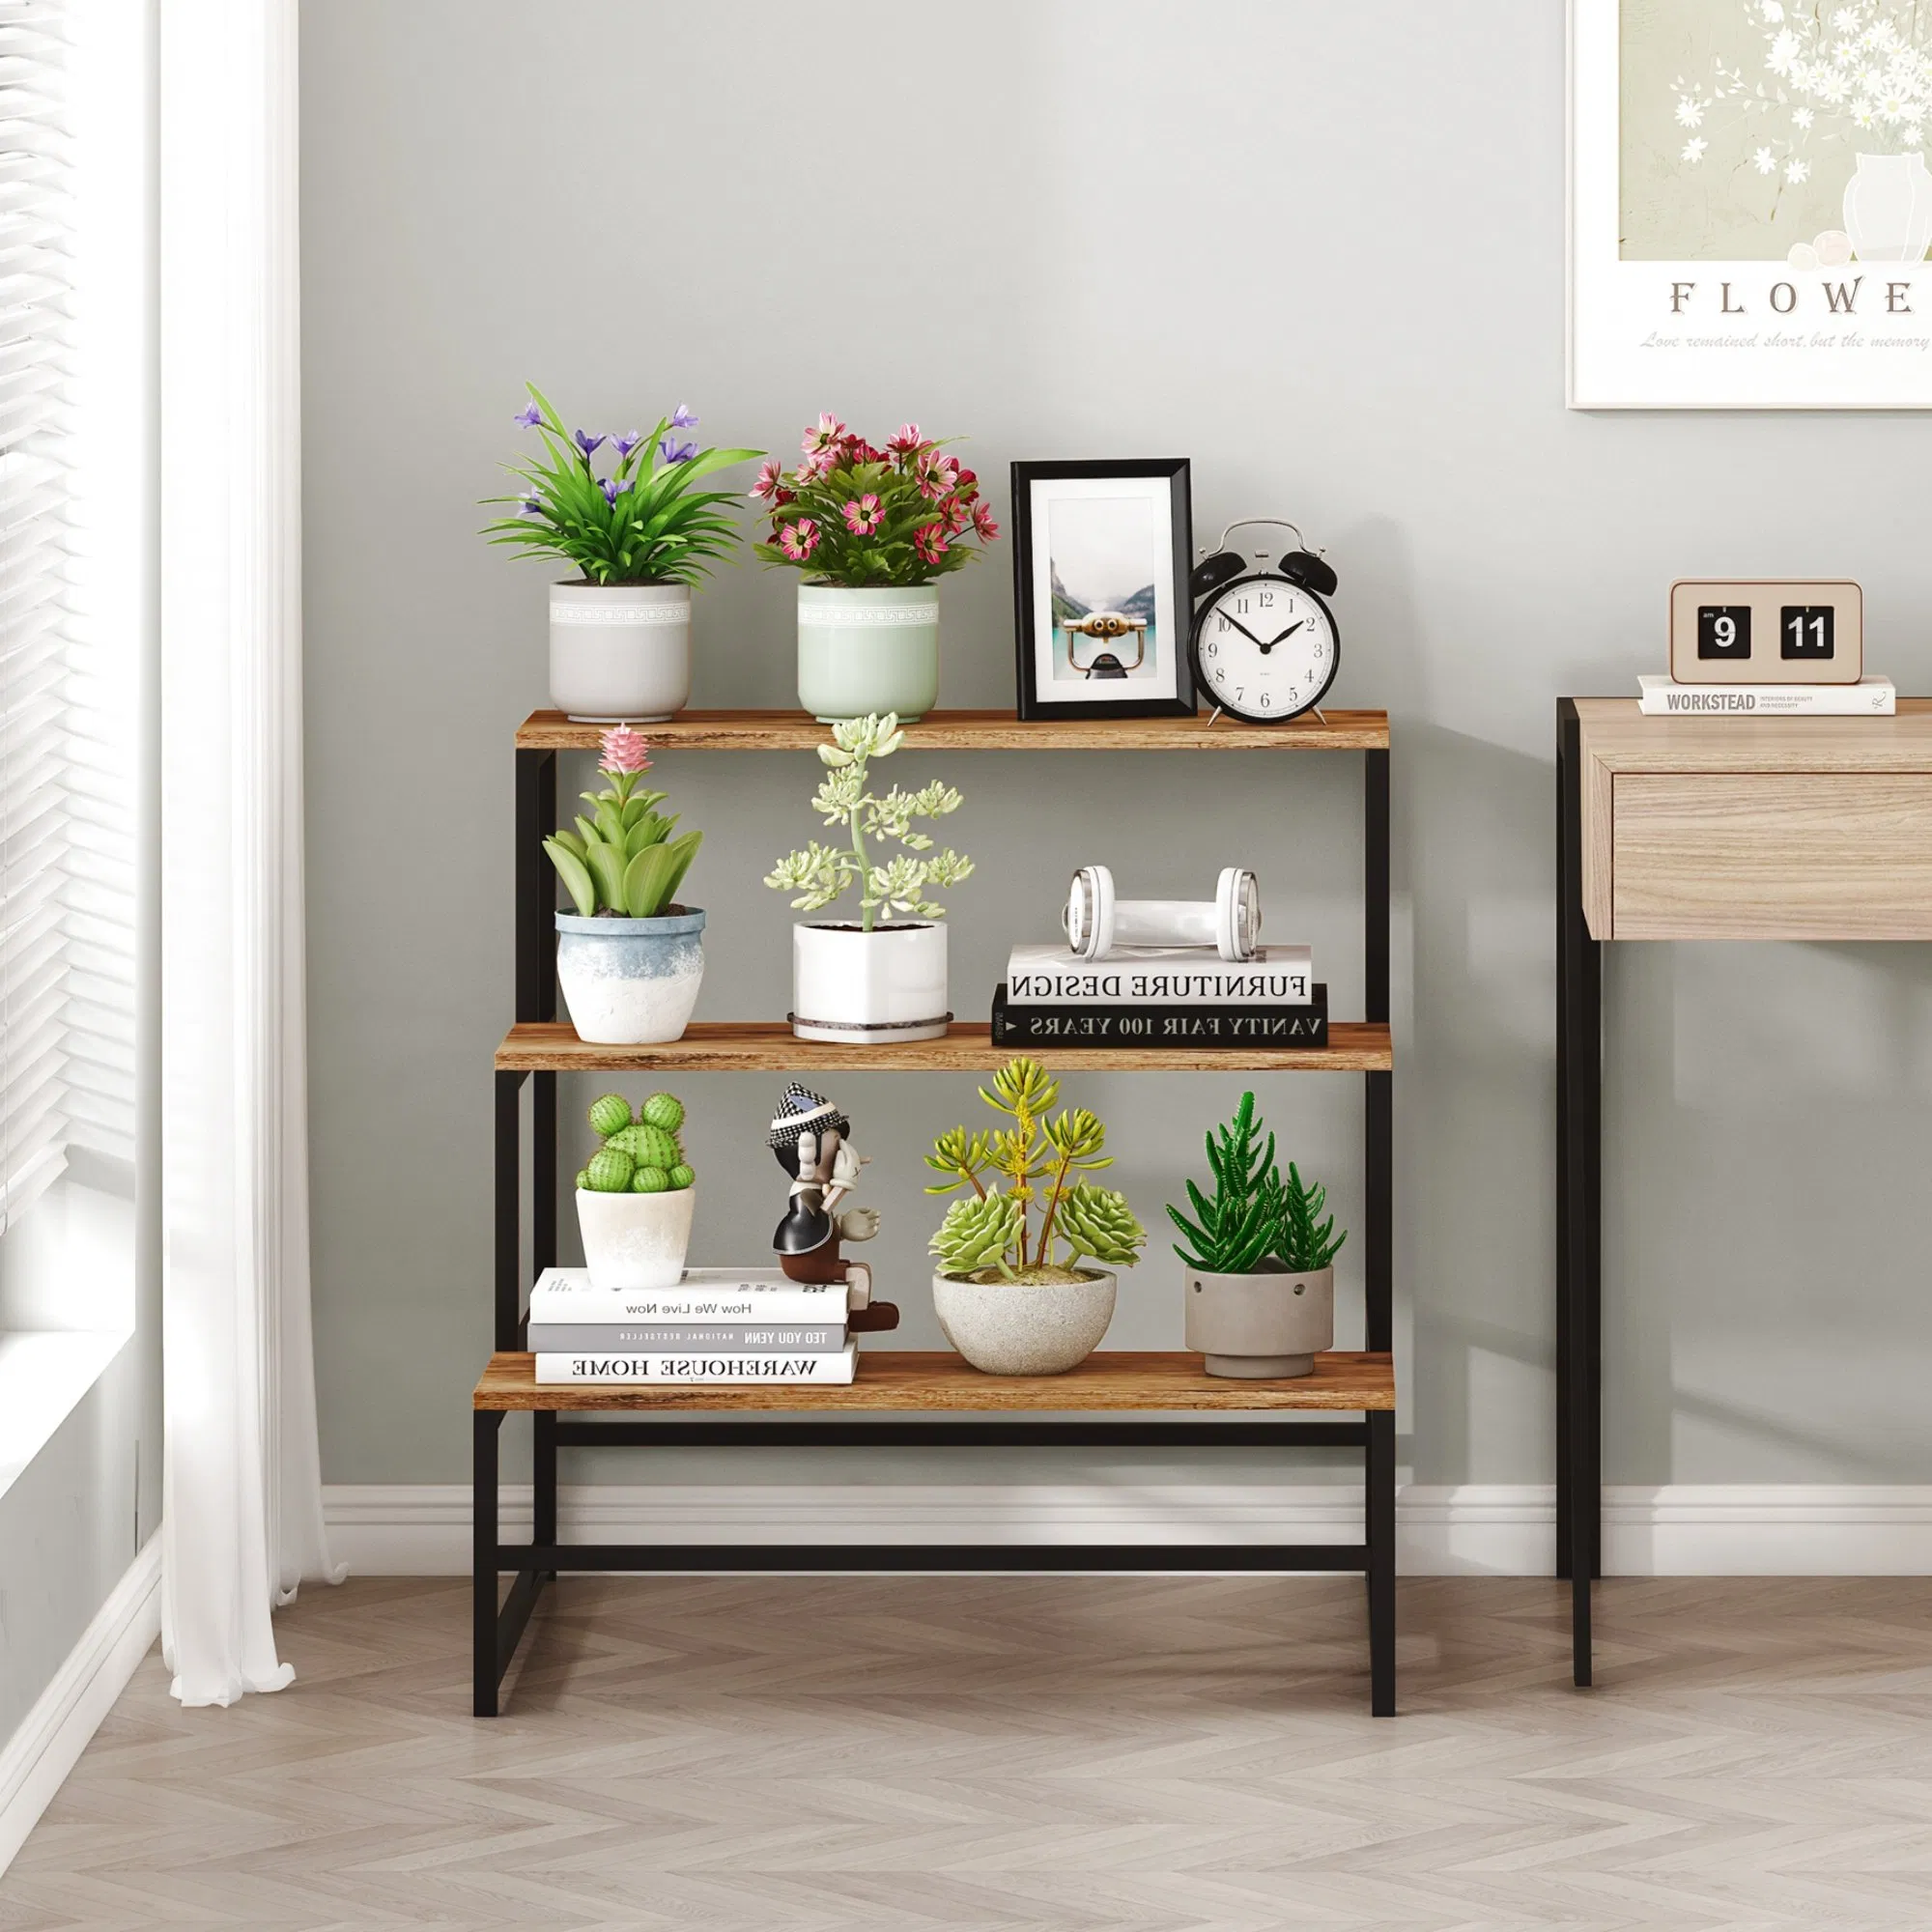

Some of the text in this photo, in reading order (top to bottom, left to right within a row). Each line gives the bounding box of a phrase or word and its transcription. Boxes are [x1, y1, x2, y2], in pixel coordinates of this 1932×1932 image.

[1639, 330, 1680, 348] Love
[1686, 331, 1759, 348] remained
[1840, 330, 1865, 348] the
[1869, 336, 1931, 353] memory
[1236, 598, 1249, 613] 11
[1259, 592, 1274, 608] 12
[1289, 599, 1294, 613] 1
[1218, 617, 1232, 633] 10
[1306, 616, 1316, 632] 2
[1714, 615, 1825, 647] 9 11
[1208, 642, 1218, 658] 9
[1314, 643, 1323, 658] 3
[1215, 668, 1226, 682] 8
[1304, 668, 1315, 683] 4
[1236, 687, 1245, 701] 7
[1261, 693, 1270, 707] 6
[1289, 687, 1298, 701] 5
[1666, 694, 1756, 710] WORKSTEAD
